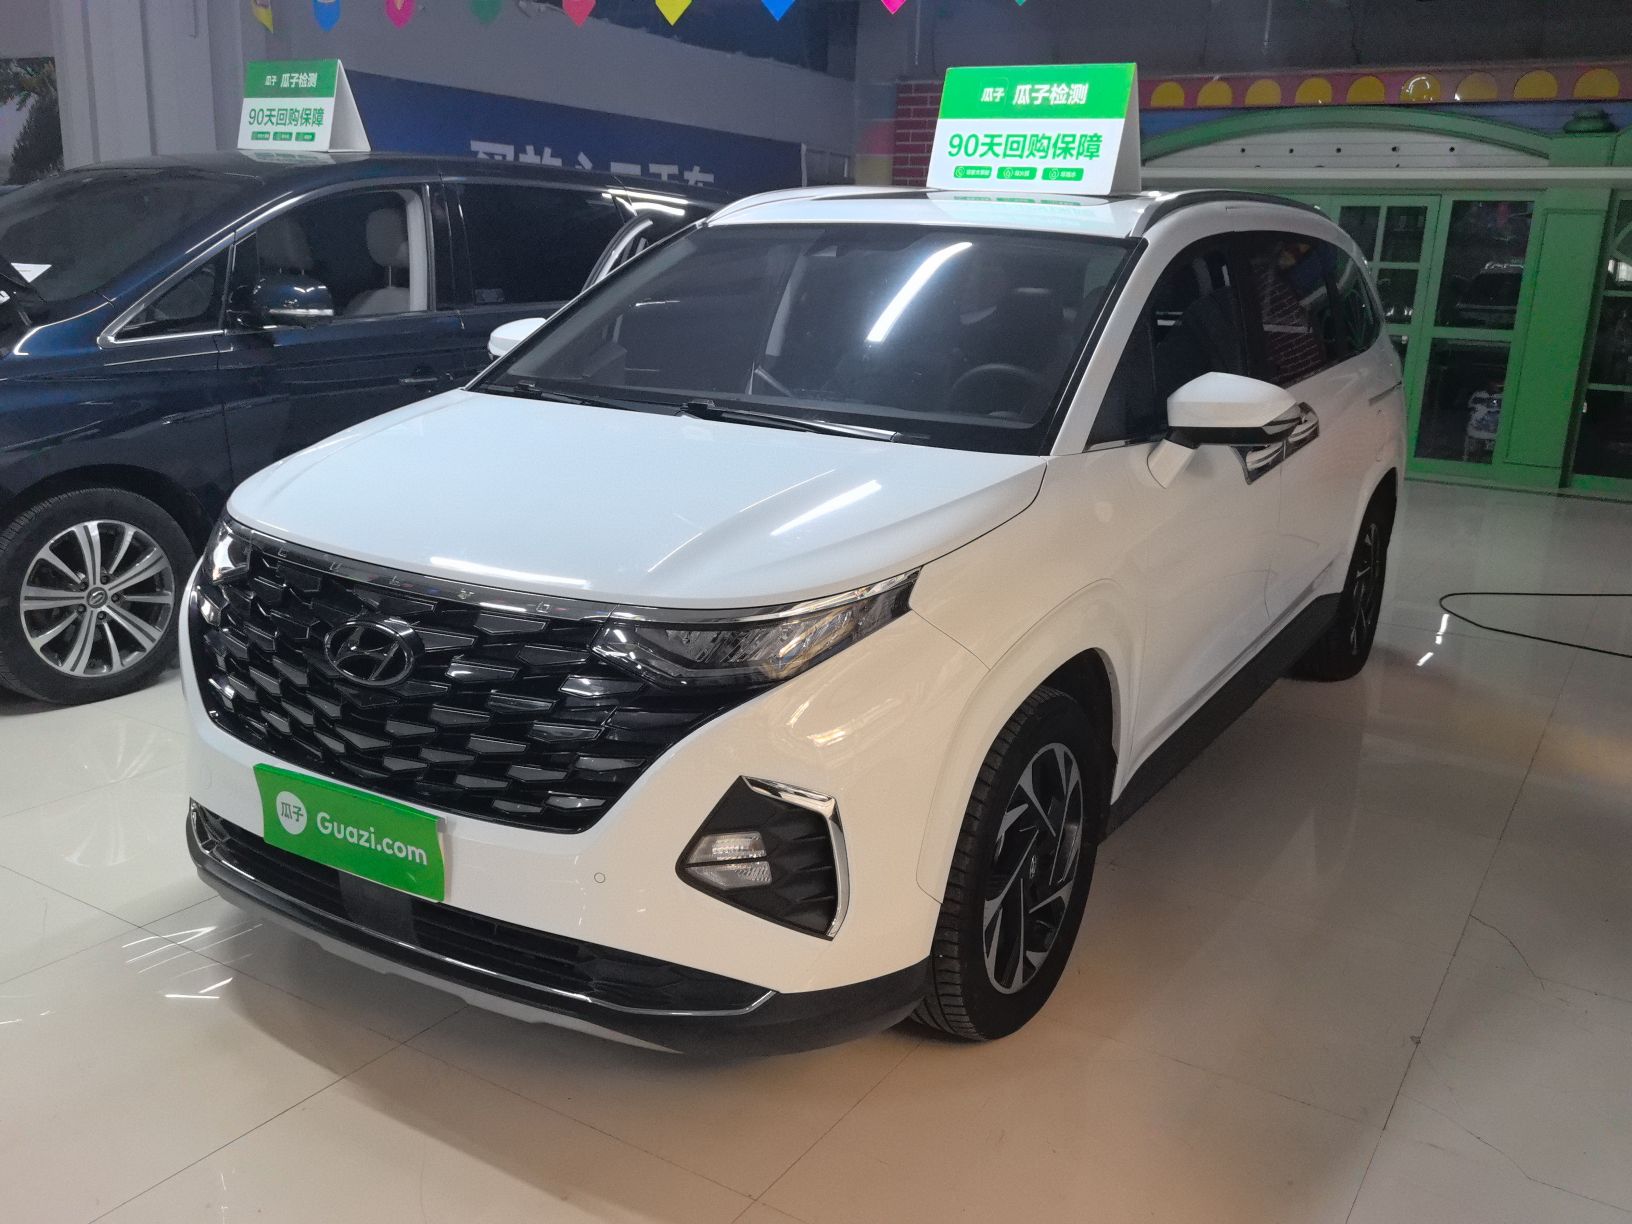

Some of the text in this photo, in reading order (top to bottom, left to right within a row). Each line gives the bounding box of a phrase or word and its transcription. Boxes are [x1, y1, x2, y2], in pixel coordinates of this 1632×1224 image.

[280, 72, 318, 88] 瓜子检测
[981, 83, 1089, 105] 瓜子 瓜子检测
[248, 107, 325, 127] 90天回购保障
[948, 132, 1103, 161] 90天回购保障
[280, 801, 304, 822] 瓜子
[316, 811, 428, 866] Guazi.com
